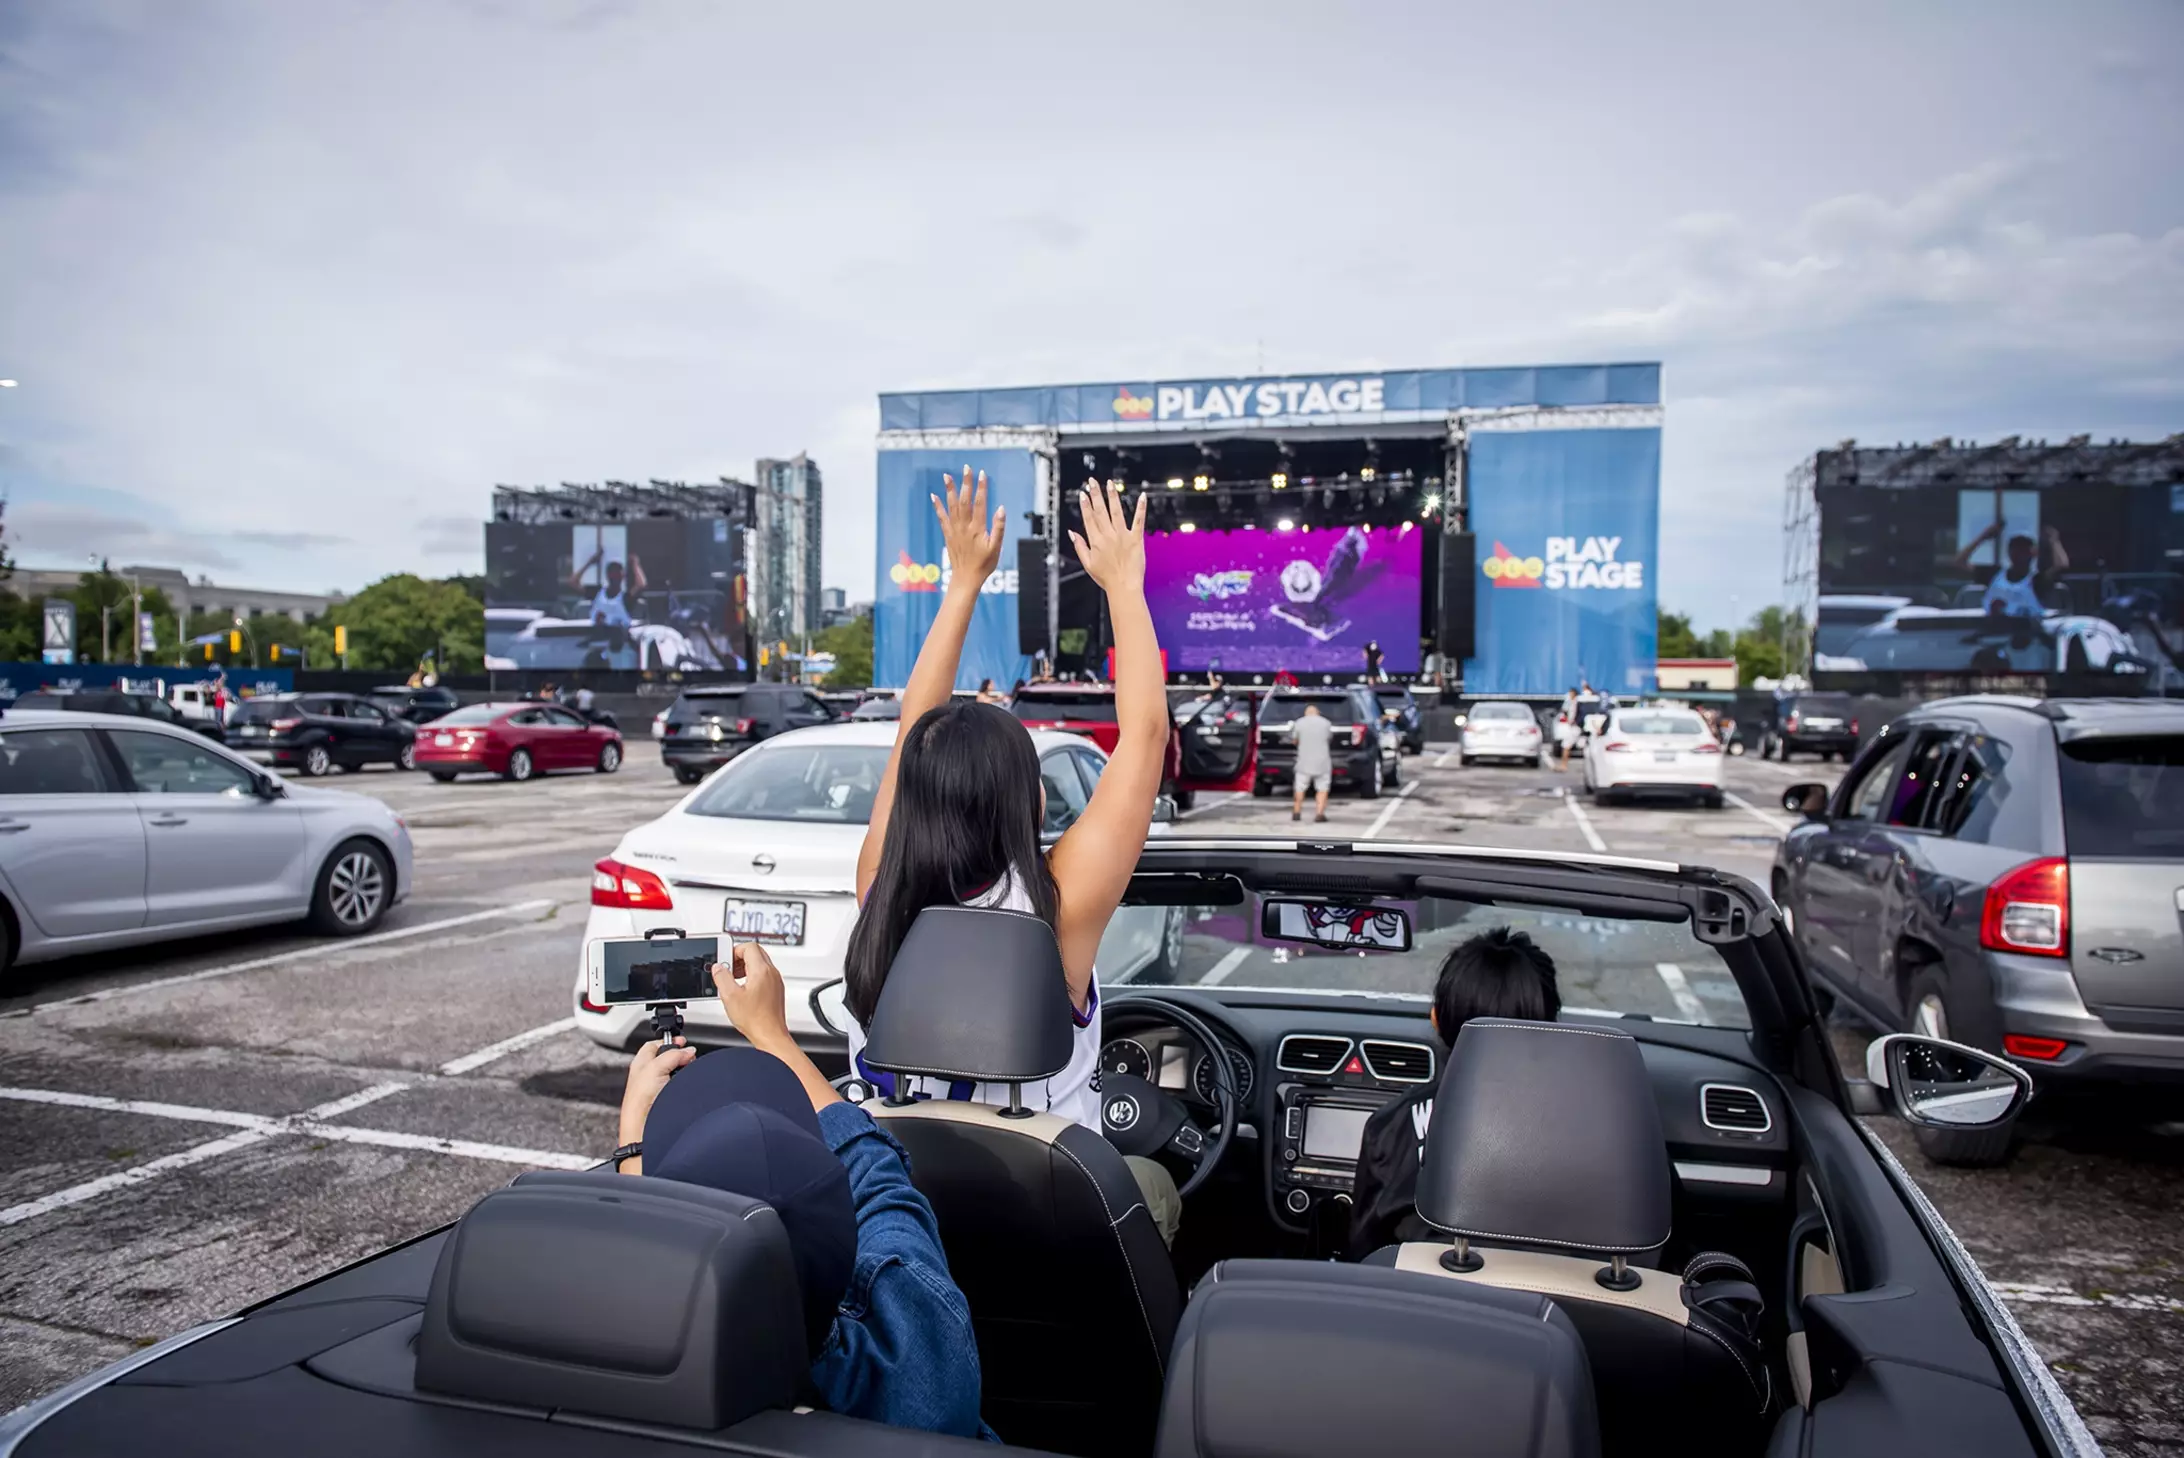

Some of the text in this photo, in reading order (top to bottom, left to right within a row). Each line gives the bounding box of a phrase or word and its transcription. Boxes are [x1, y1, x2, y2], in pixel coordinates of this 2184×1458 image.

[1157, 384, 1252, 420] PLAY
[1256, 378, 1385, 416] STAGE
[1545, 536, 1622, 562] PLAY
[1544, 561, 1644, 589] STAGE
[726, 910, 801, 936] CJYD 326
